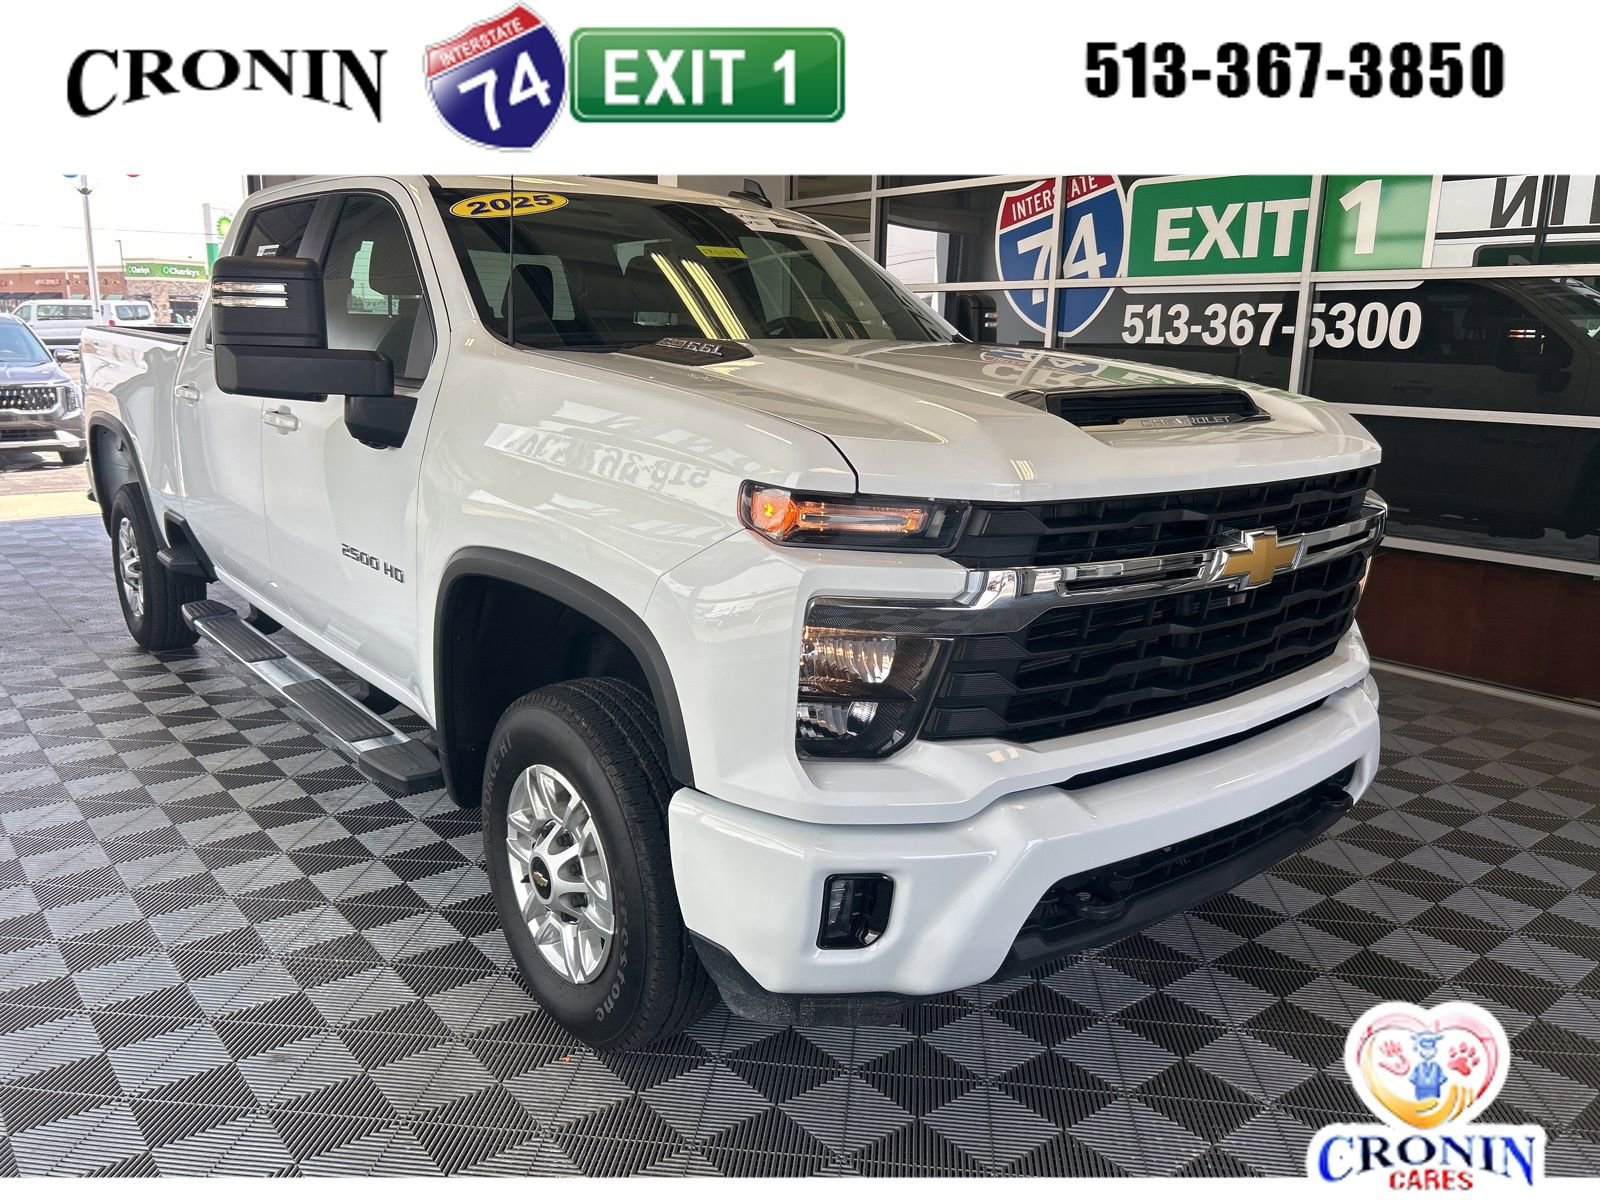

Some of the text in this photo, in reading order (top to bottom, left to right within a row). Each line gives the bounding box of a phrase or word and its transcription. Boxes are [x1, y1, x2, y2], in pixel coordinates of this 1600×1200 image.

[466, 194, 555, 216] 2025
[1011, 174, 1099, 222] INTERATE
[1153, 179, 1382, 262] EXIT 1
[1016, 212, 1108, 306] 74
[1121, 301, 1422, 350] 513-367-5300
[1142, 415, 1230, 428] CHEVROLET
[341, 542, 404, 584] 2500 HD
[595, 885, 629, 1022] irestone
